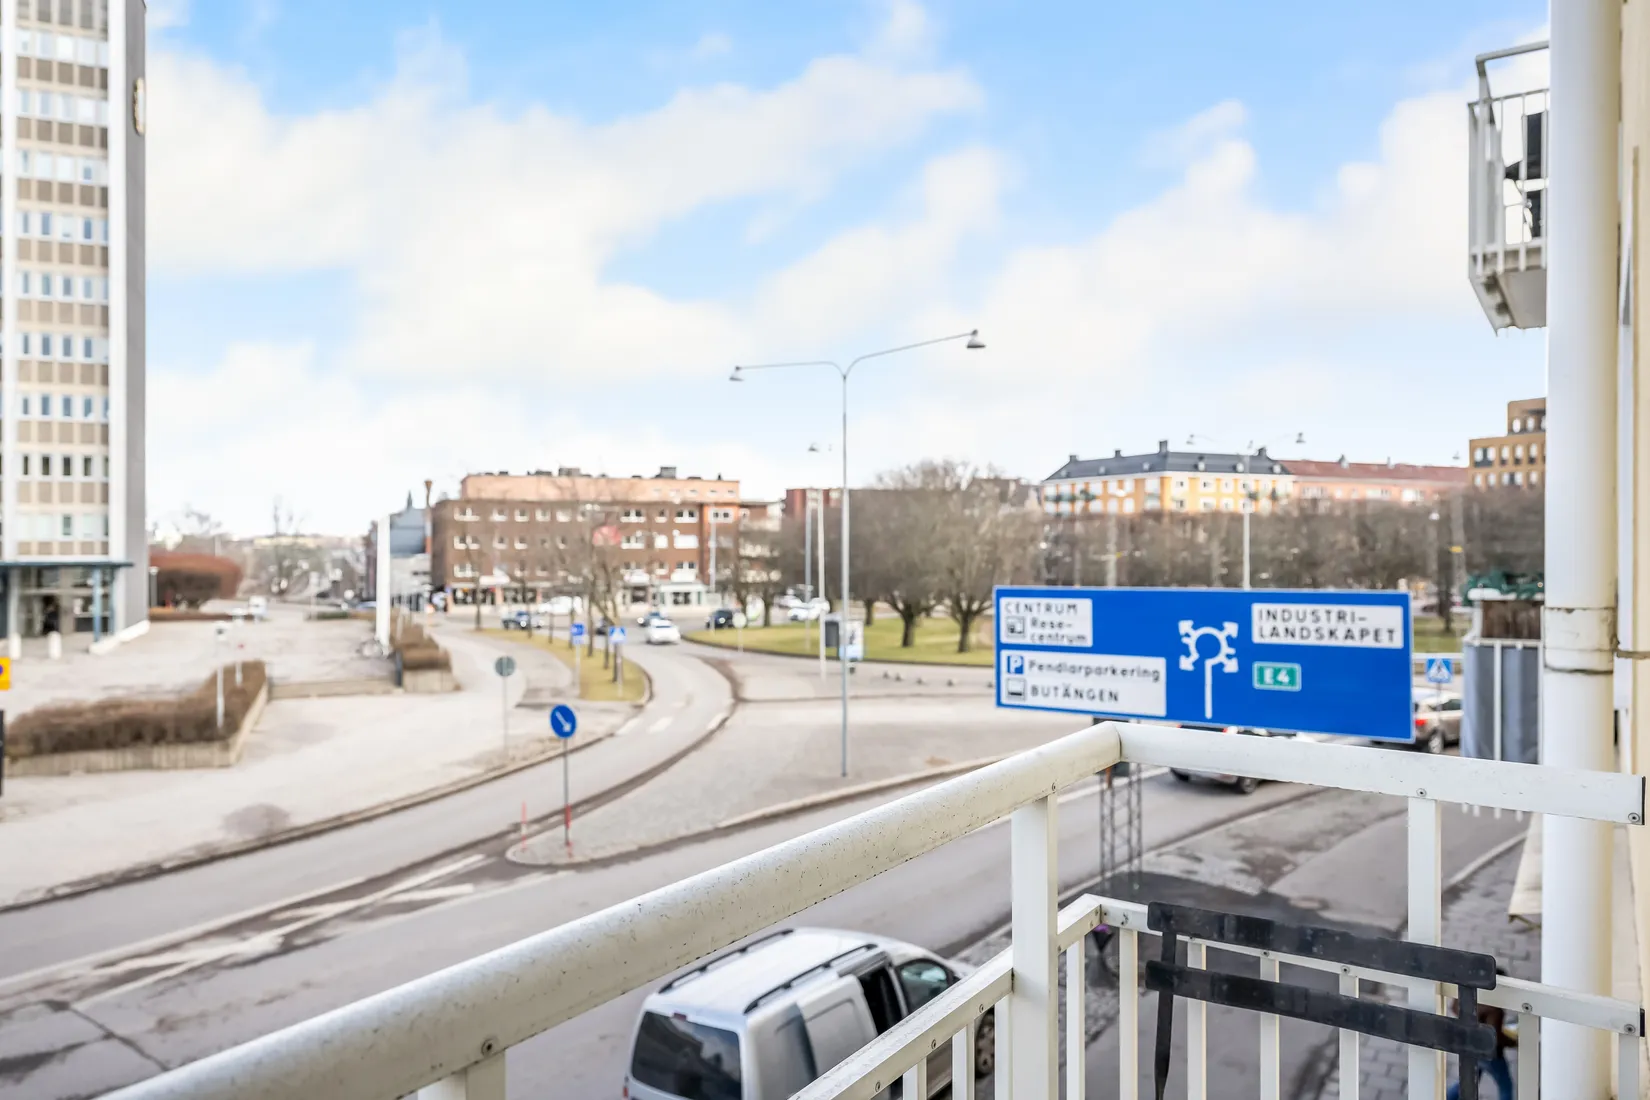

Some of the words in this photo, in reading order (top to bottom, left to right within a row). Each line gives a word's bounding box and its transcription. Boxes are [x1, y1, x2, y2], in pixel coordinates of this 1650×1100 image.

[1005, 602, 1078, 615] CENTRUM
[1258, 608, 1368, 624] INDUSTRI-
[1031, 617, 1073, 629] Rese-
[1031, 632, 1088, 644] centrum
[1258, 626, 1396, 643] LANDSKAPET
[1029, 660, 1160, 682] Pendlarparkering
[1263, 667, 1290, 685] E4
[1031, 683, 1119, 702] BUTÄNGEN
